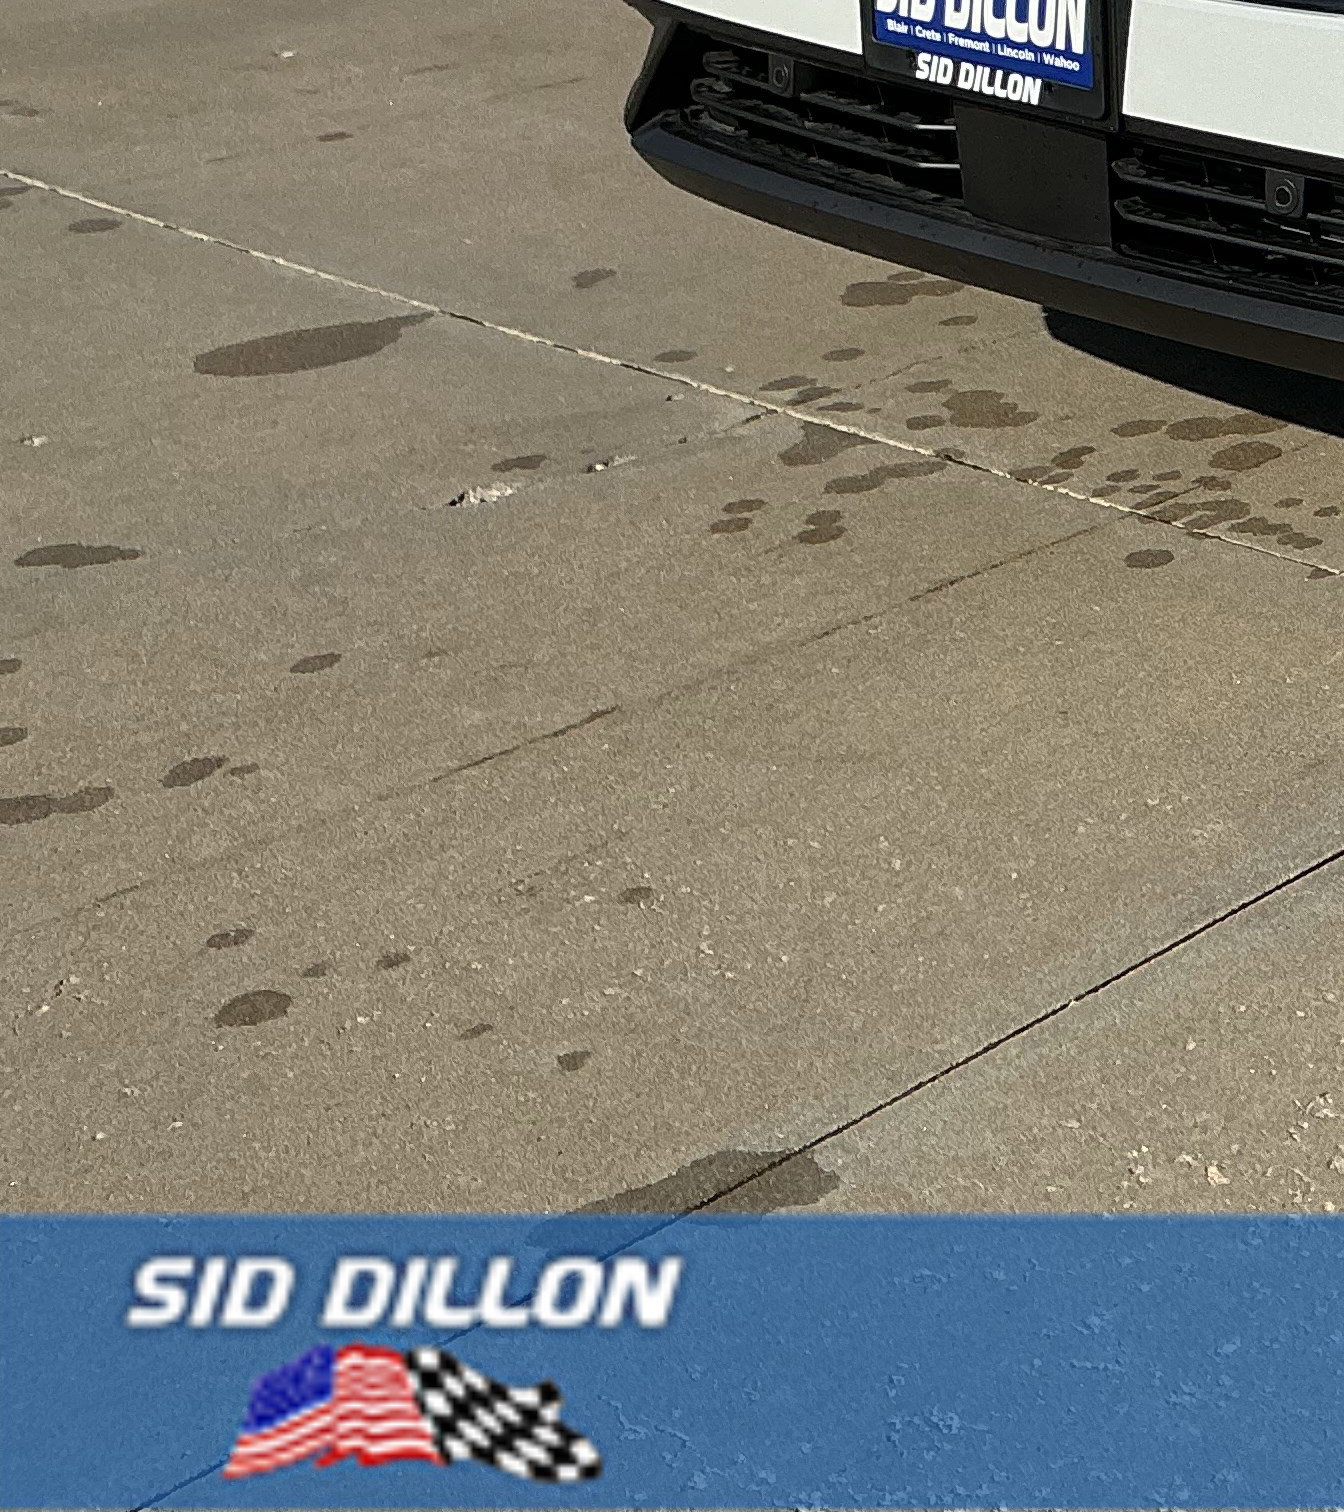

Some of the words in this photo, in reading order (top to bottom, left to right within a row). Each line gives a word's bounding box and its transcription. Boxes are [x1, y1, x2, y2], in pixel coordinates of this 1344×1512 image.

[886, 18, 909, 35] Blair
[914, 25, 942, 42] Crete
[947, 33, 991, 53] Fremont
[997, 43, 1036, 62] Lincoln
[1042, 52, 1081, 72] Wahoo
[915, 51, 954, 85] SID
[956, 61, 1043, 106] DILLON
